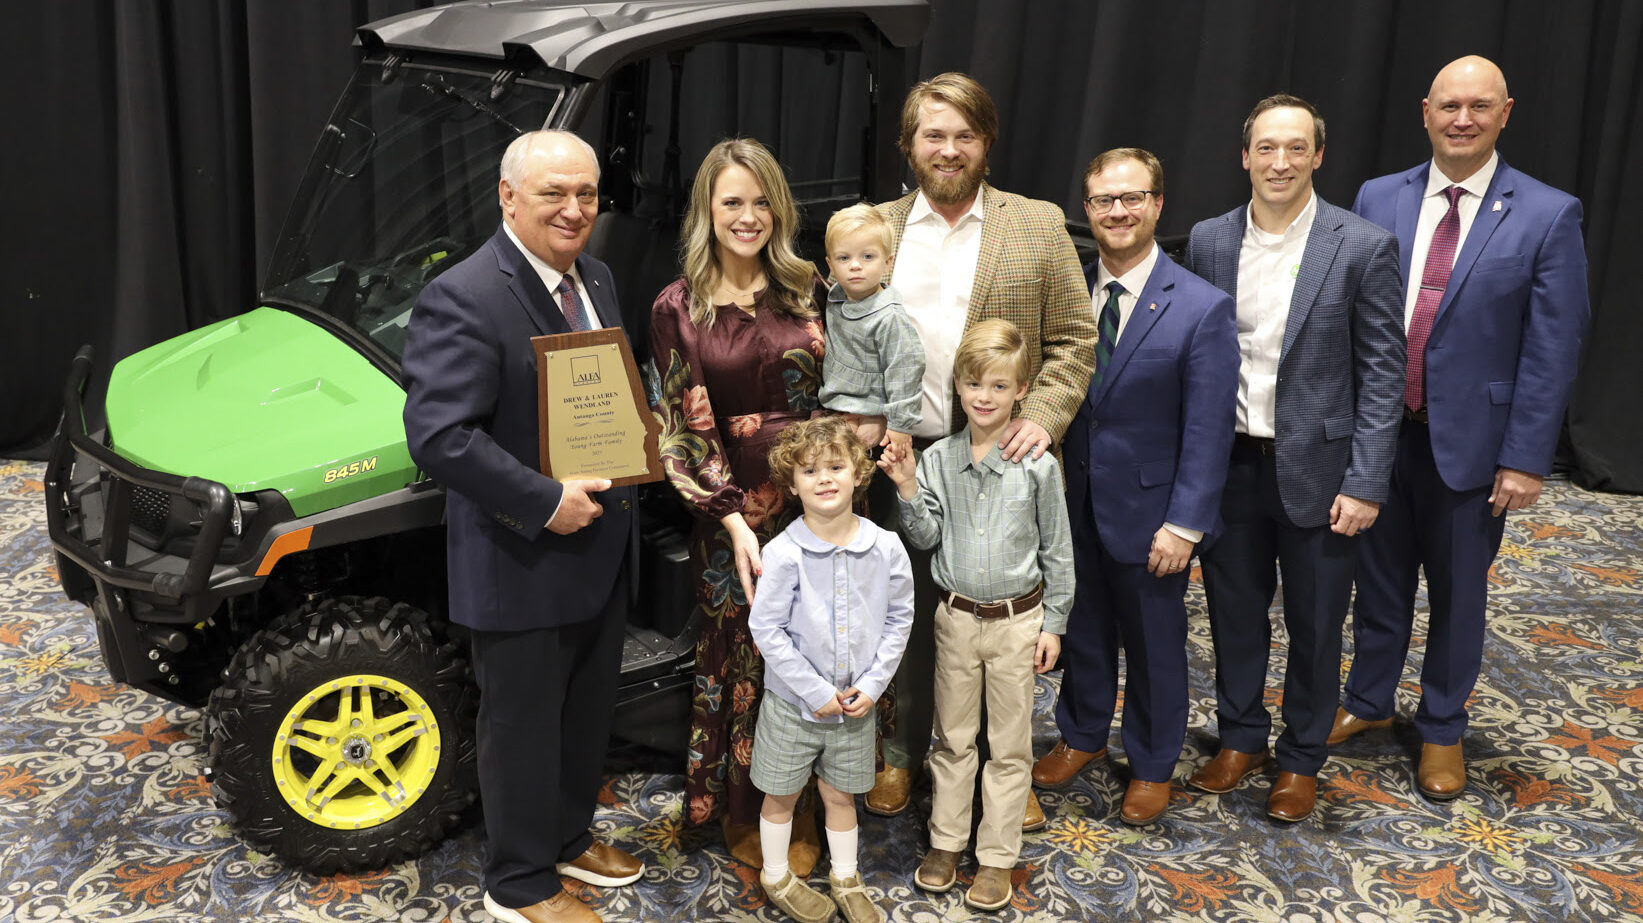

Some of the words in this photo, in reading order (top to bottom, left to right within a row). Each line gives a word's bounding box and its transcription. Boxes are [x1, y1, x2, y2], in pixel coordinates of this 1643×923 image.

[577, 372, 601, 382] ALFA
[563, 396, 582, 404] DREW
[592, 392, 618, 400] LAUREN
[573, 400, 611, 410] WENDLAND
